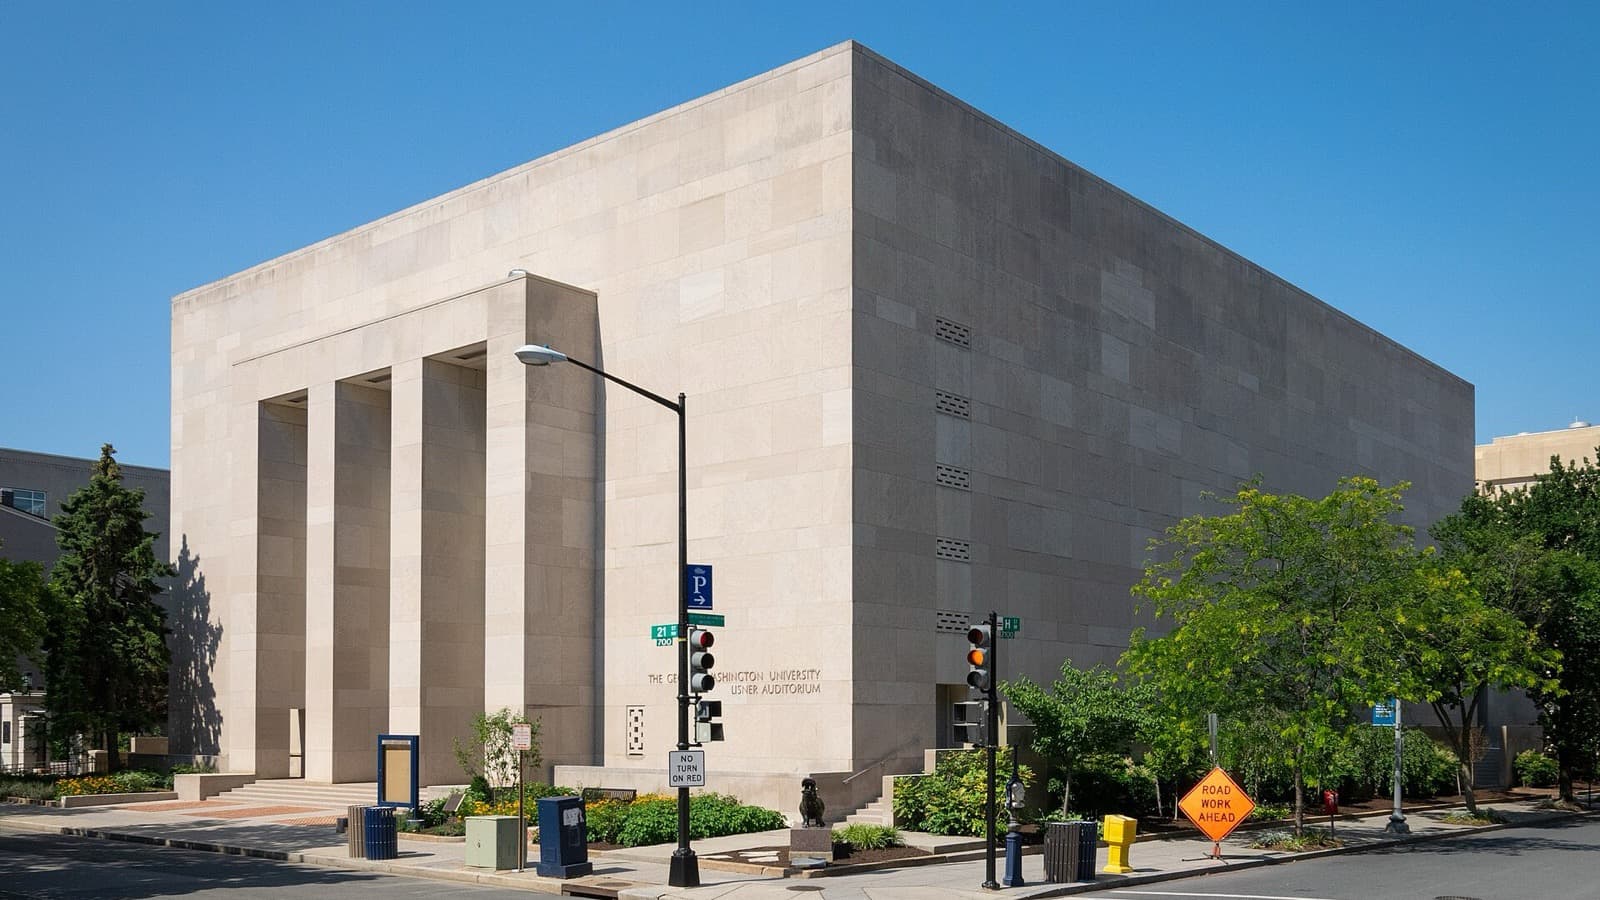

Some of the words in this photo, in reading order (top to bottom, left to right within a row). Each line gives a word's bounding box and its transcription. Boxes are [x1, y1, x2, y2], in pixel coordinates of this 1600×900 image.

[693, 576, 706, 593] P
[1004, 618, 1011, 630] H
[656, 626, 667, 638] 21
[657, 638, 672, 646] 700
[648, 674, 663, 684] THE
[711, 671, 763, 683] ASHINGTON
[769, 669, 820, 681] UNIVERSITY
[731, 684, 758, 695] LISNER
[761, 683, 821, 695] AUDITORIUM
[672, 774, 684, 782] ON
[686, 774, 702, 782] RED
[1202, 785, 1231, 795] ROAD
[1201, 799, 1231, 809] WORK
[1199, 812, 1236, 823] AHEAD
